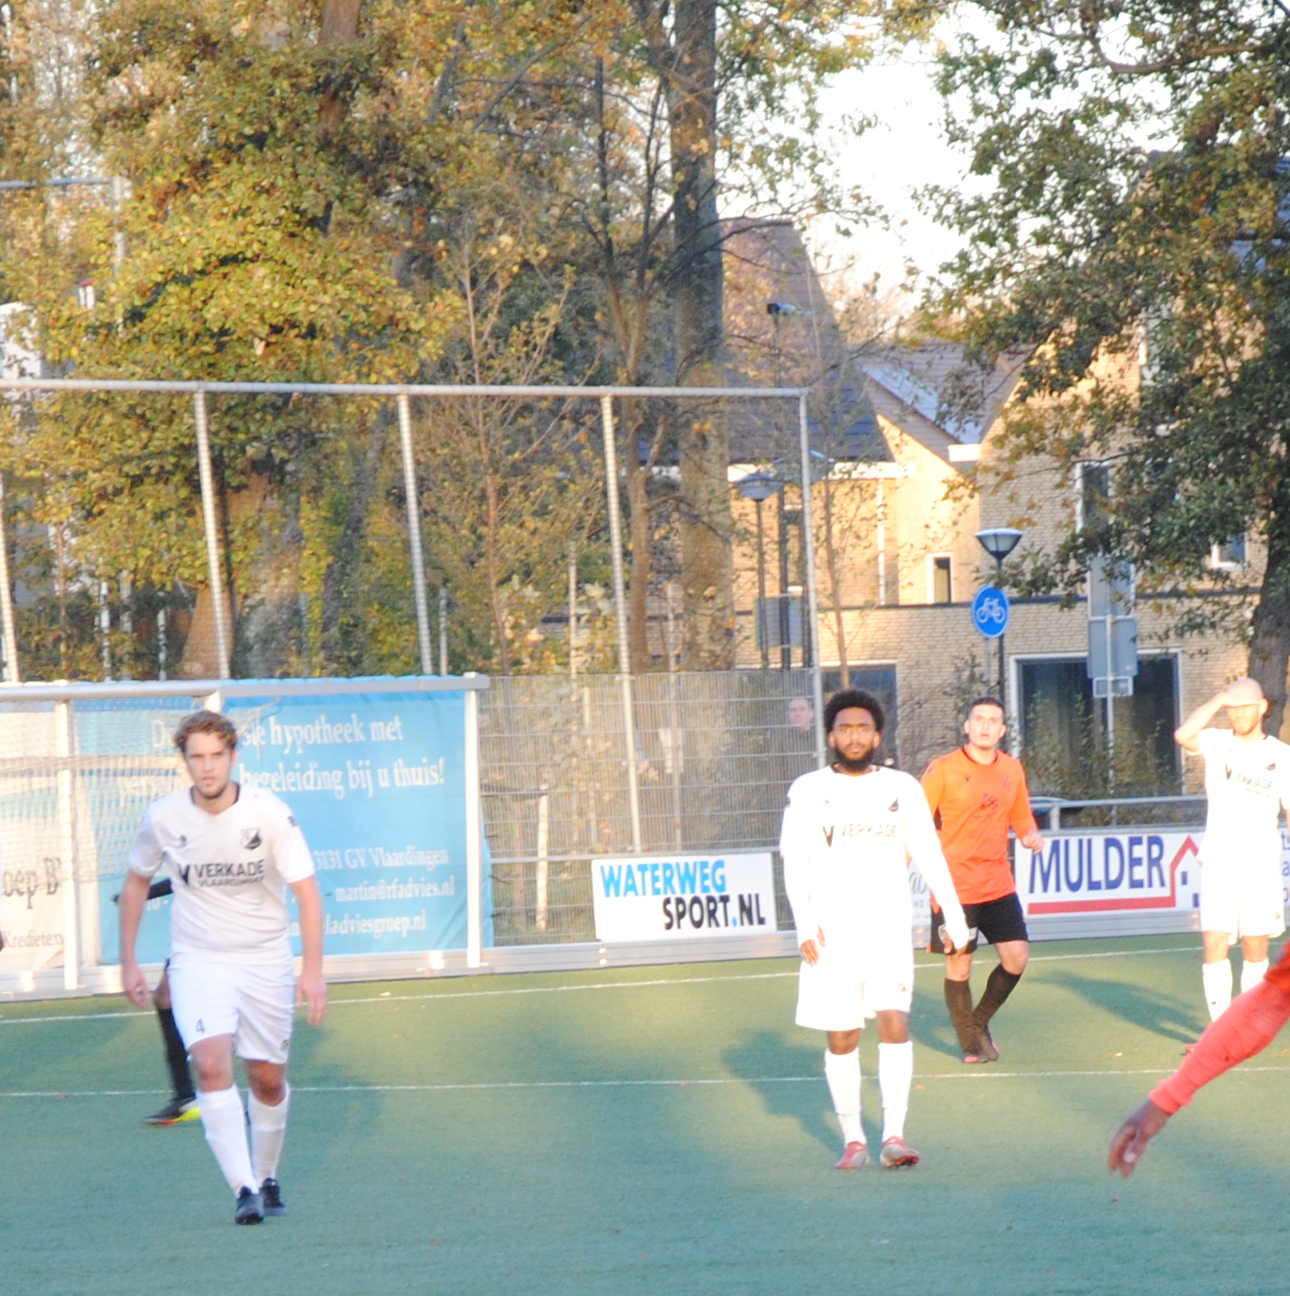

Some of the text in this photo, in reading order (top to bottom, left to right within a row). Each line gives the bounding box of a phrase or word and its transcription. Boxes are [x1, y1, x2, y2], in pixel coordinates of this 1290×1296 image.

[269, 713, 365, 754] hypotheek
[370, 715, 404, 742] met
[347, 758, 374, 798] bij
[377, 767, 391, 788] u
[393, 757, 445, 787] thuis!
[839, 823, 897, 838] VERKADE
[194, 859, 266, 878] VERKADE
[345, 848, 366, 870] GV
[369, 845, 449, 871] Vlaardingen
[1028, 835, 1166, 894] MULDER
[600, 859, 727, 898] WATERWEG
[662, 893, 766, 930] SPORT.NL
[195, 1018, 206, 1035] 4
